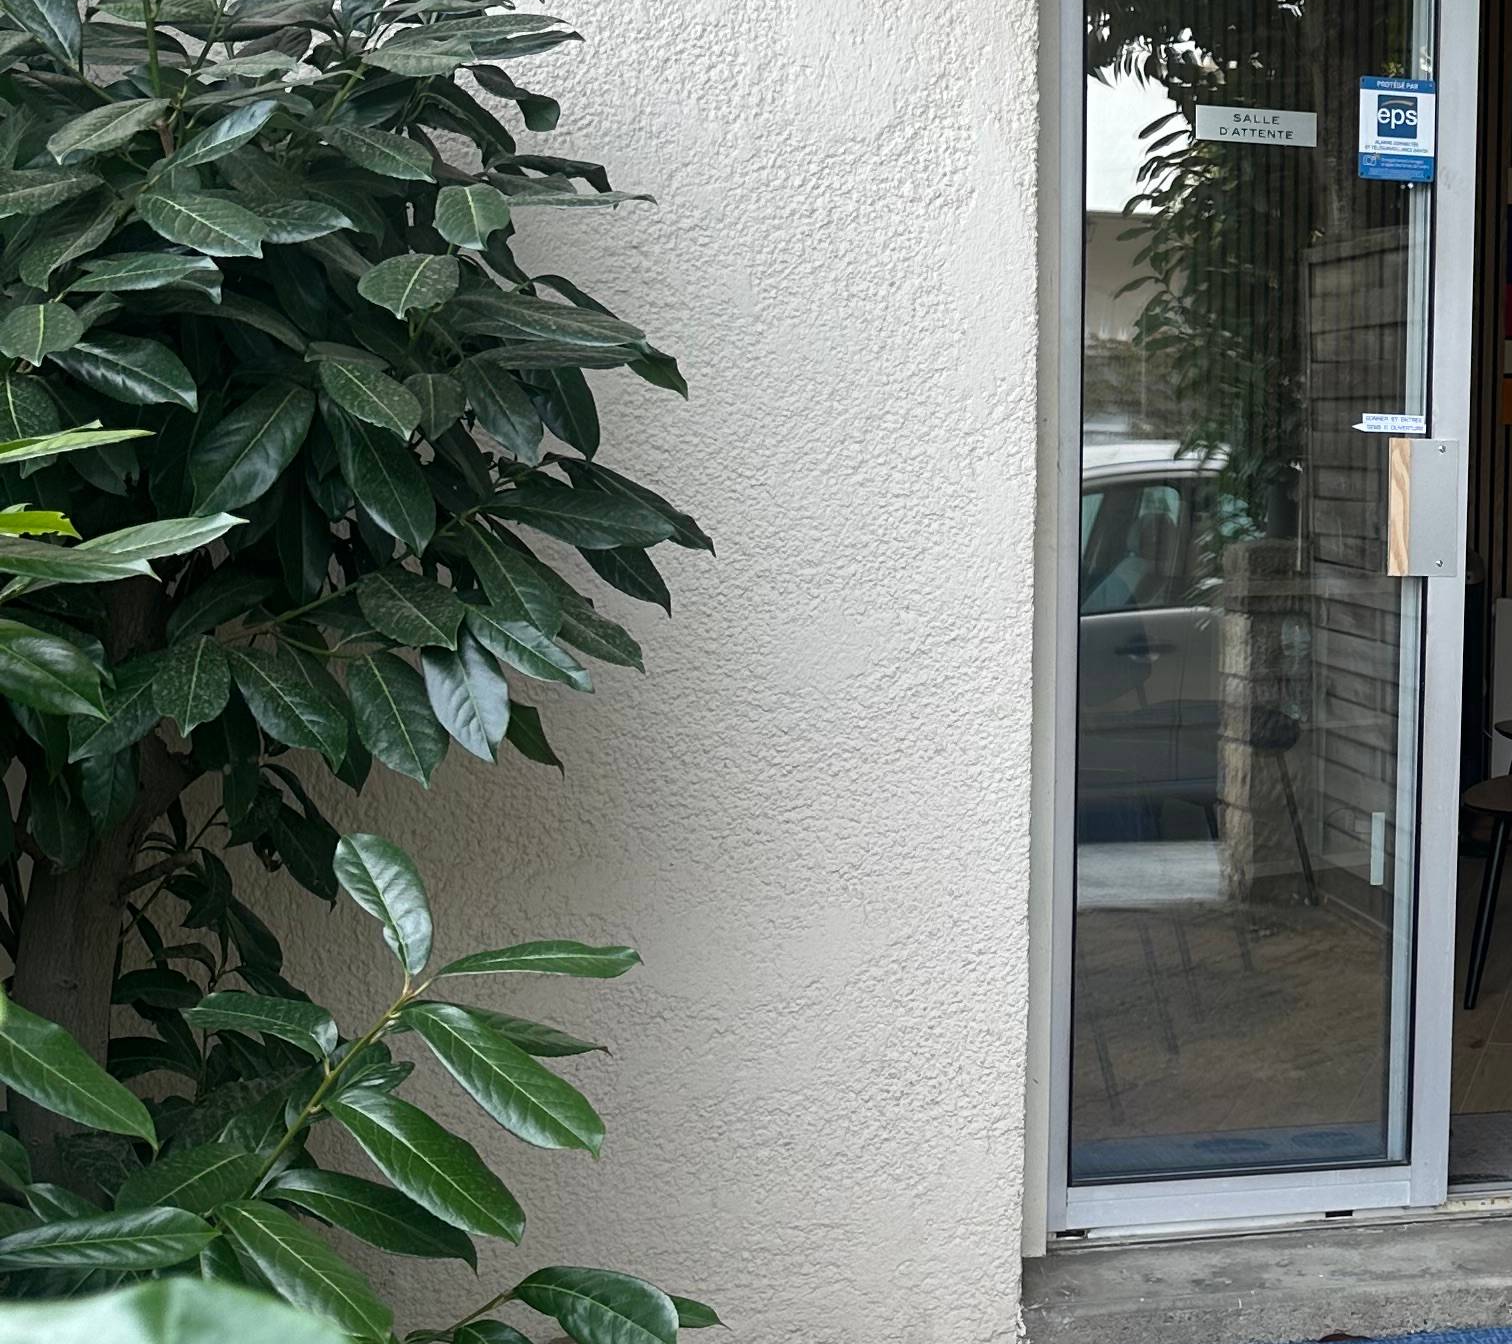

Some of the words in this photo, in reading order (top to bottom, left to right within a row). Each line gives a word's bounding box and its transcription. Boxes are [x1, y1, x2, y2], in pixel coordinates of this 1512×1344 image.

[1406, 82, 1419, 90] PAR
[1233, 113, 1281, 125] SALLE
[1377, 108, 1418, 129] eps
[1219, 126, 1294, 140] D'ATTENTE
